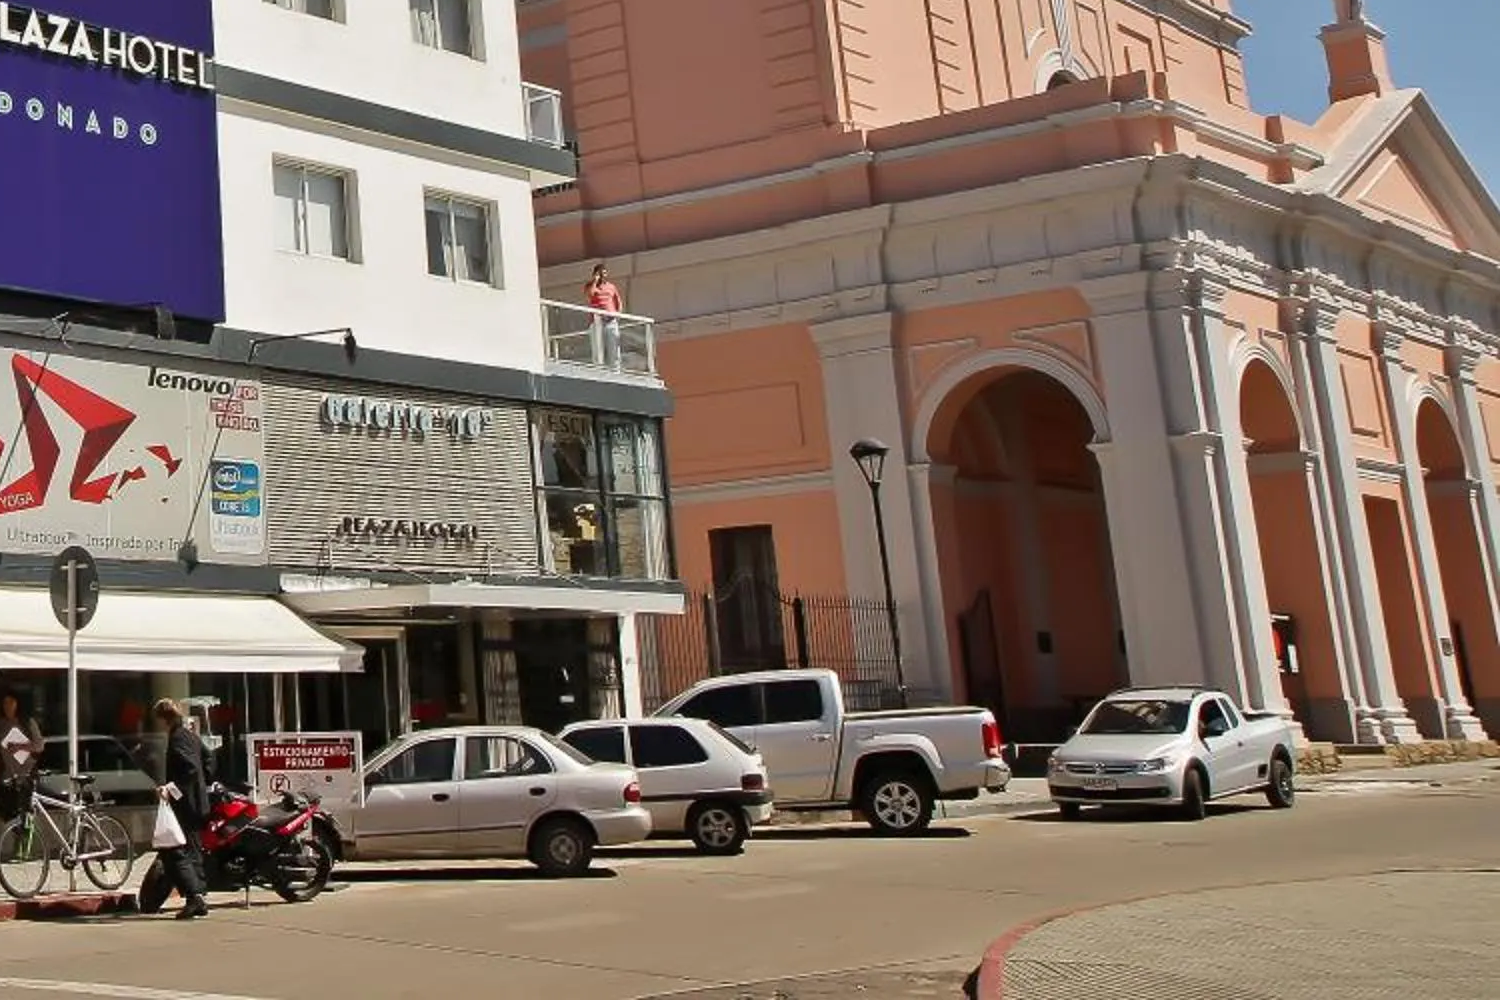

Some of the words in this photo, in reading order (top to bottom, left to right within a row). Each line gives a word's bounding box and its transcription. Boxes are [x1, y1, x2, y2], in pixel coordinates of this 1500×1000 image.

[103, 27, 215, 90] HOTEL
[147, 366, 231, 395] lenovo
[0, 492, 35, 508] YOGA
[263, 746, 349, 757] ESTACIONAMIENTO
[285, 758, 325, 769] PRIVADO
